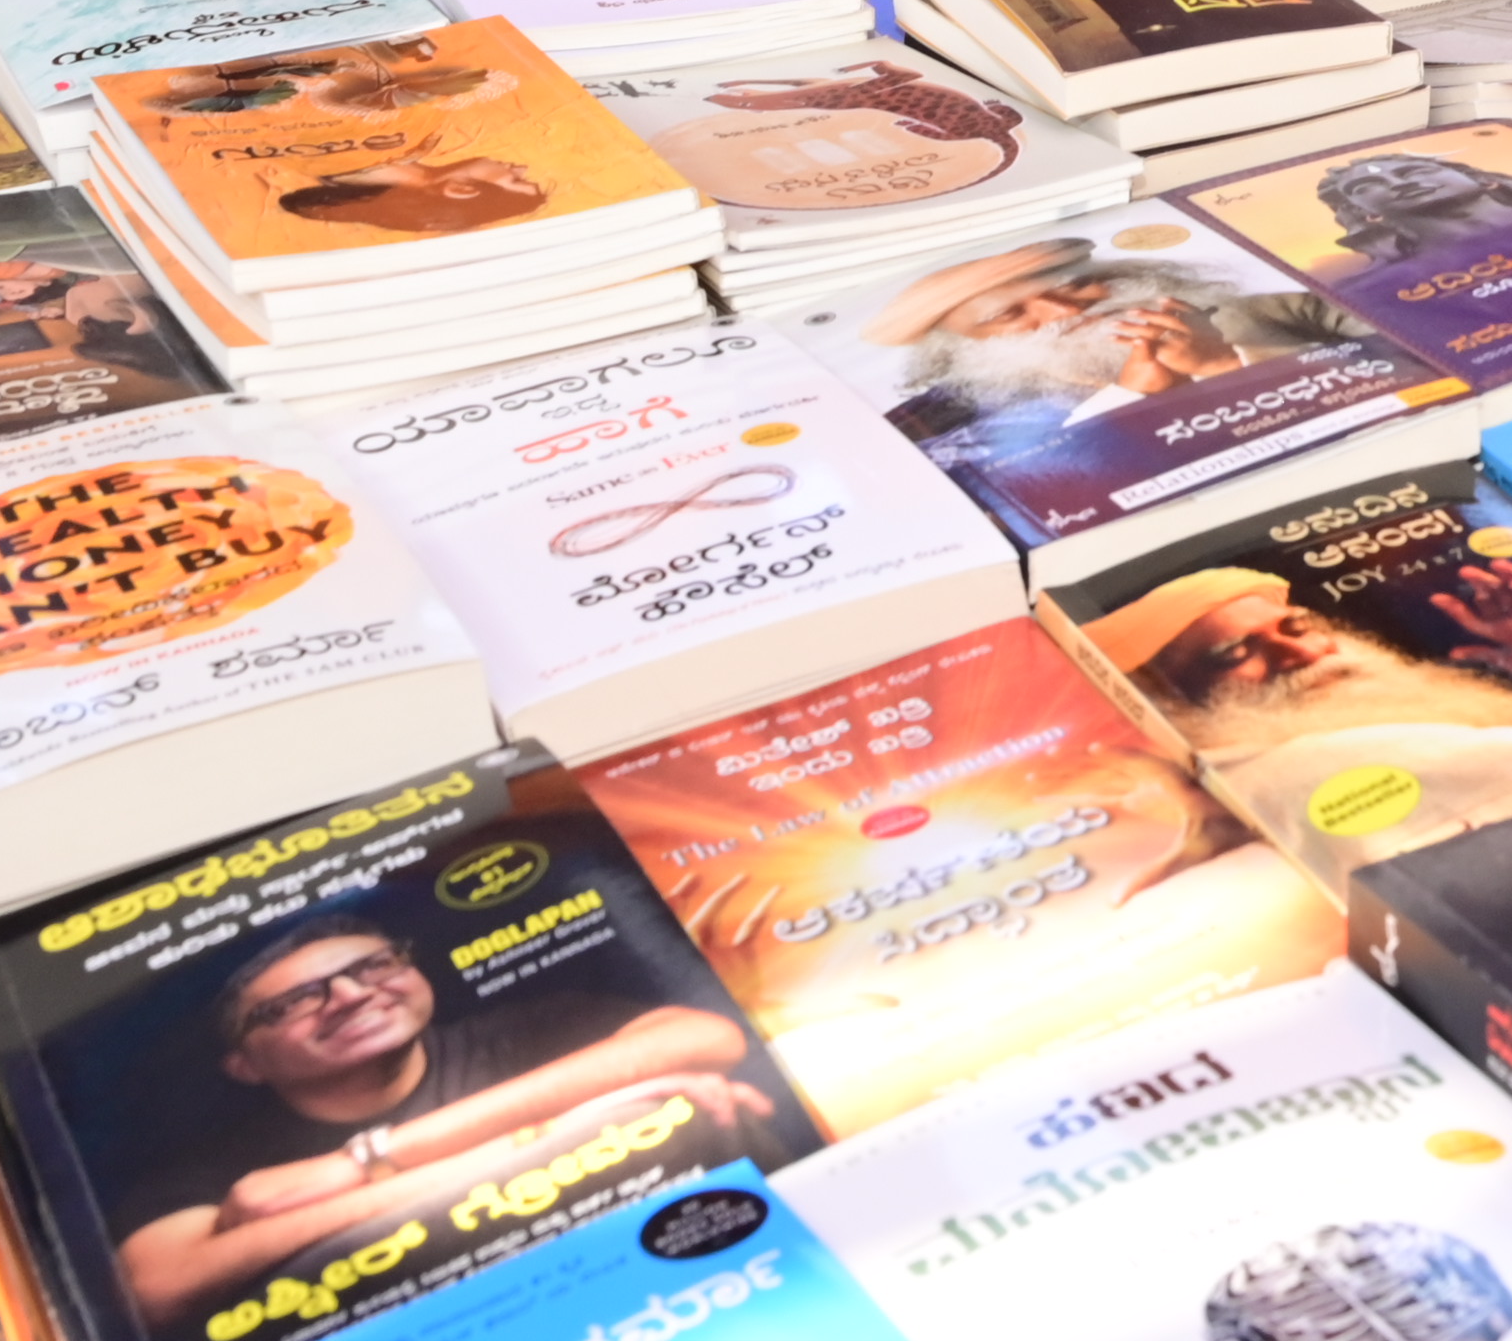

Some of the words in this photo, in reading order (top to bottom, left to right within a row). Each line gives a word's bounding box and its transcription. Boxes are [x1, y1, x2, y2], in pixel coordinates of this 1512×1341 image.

[352, 332, 758, 457] ಯಾವಾಗಲೂ
[513, 394, 690, 467] ಹಾಗೆ
[1156, 356, 1396, 448] ಸಂಬಂಧಗಳು
[544, 475, 633, 512] Same
[660, 442, 732, 475] Ever
[1118, 425, 1308, 509] Relationships
[184, 517, 336, 572] BUY
[1323, 565, 1389, 605] JOY
[207, 619, 396, 681] ಶರ್ಮಾ
[659, 829, 741, 873] The
[747, 799, 830, 847] Law
[837, 787, 875, 817] of
[885, 721, 1068, 799] Attraction
[449, 888, 606, 972] DOGLAPAN
